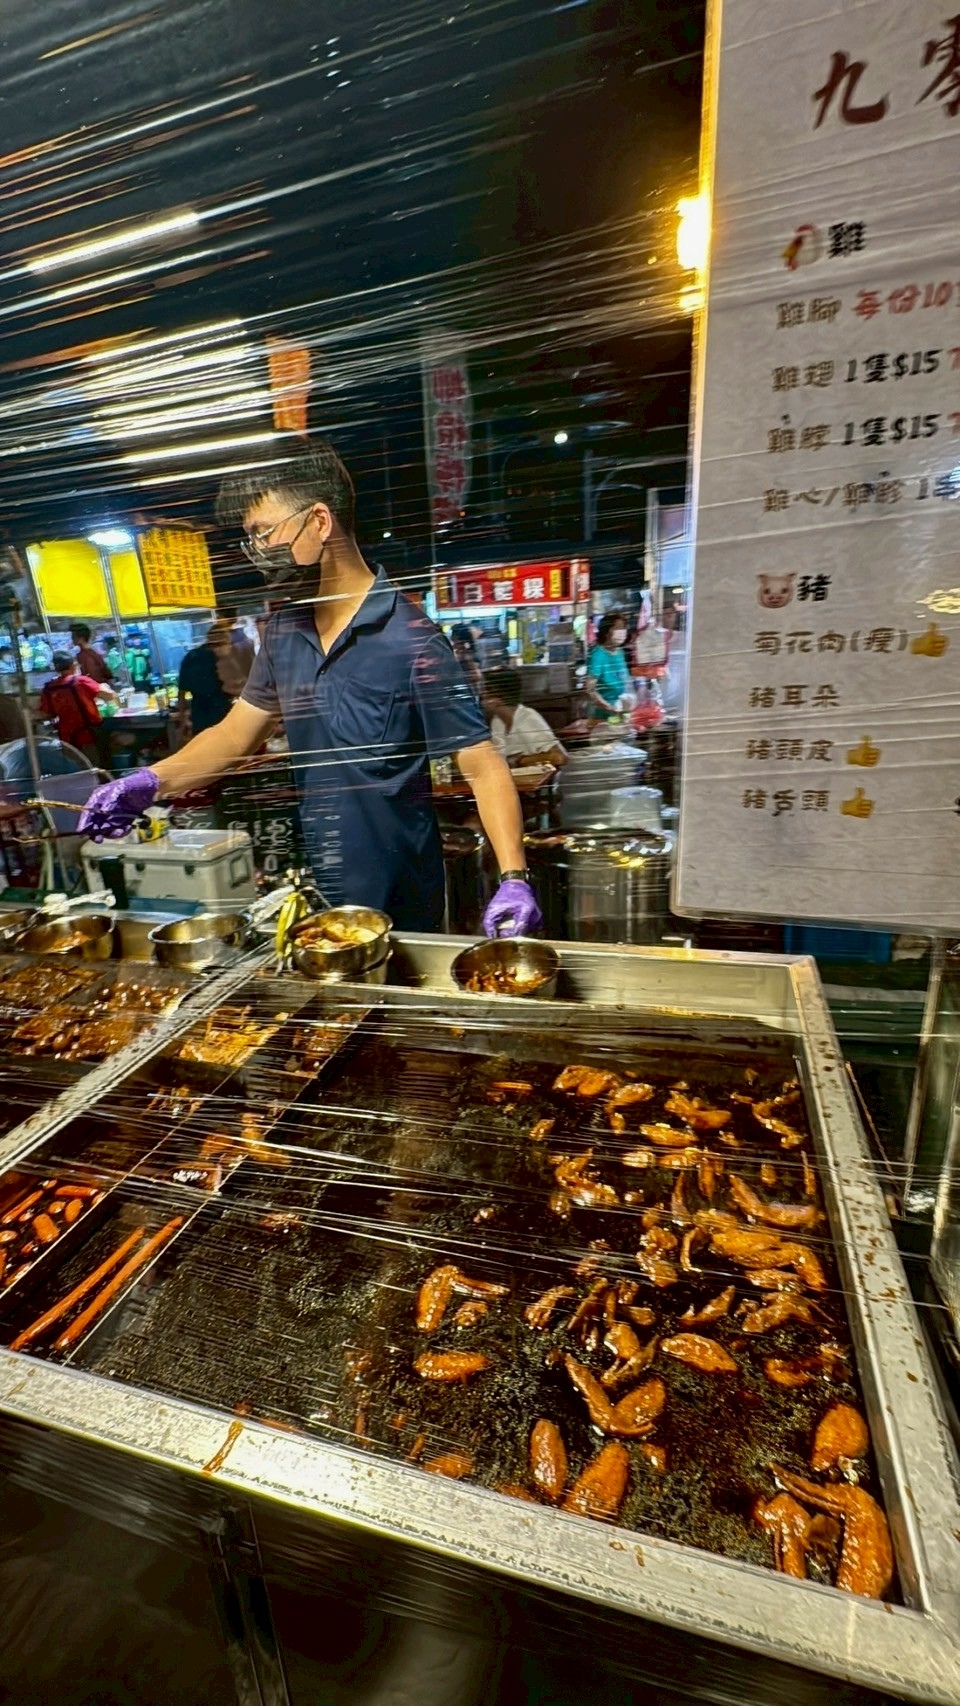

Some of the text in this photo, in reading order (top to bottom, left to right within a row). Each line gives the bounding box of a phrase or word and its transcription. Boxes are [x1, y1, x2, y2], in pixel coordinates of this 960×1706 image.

[827, 221, 867, 258] 雞
[852, 281, 960, 320] 每份10
[772, 360, 834, 392] 雞翅
[797, 573, 833, 602] 豬
[749, 684, 840, 708] 豬耳朵
[746, 738, 834, 762] 豬頭皮
